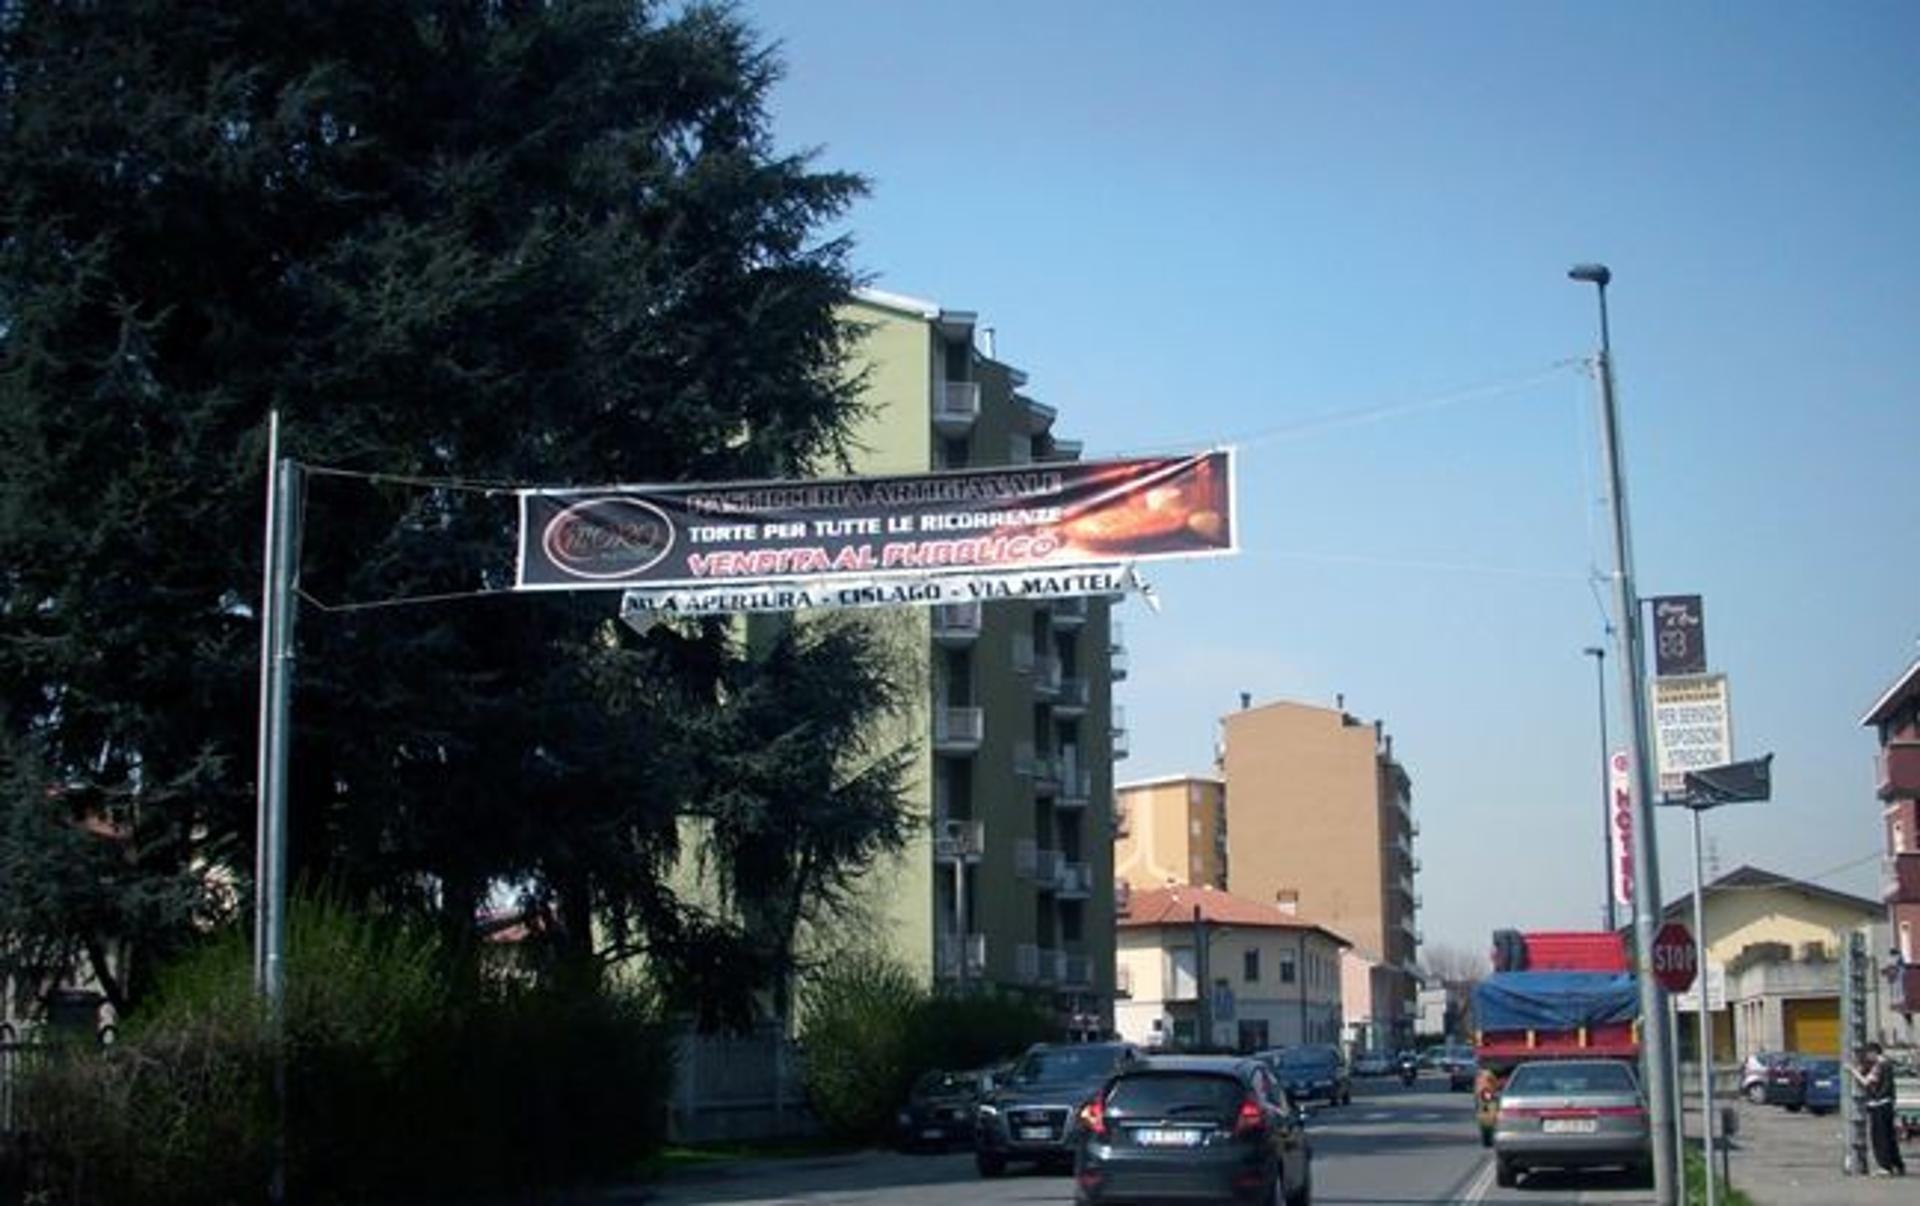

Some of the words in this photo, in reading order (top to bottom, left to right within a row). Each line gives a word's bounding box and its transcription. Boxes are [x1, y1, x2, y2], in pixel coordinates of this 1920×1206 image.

[688, 523, 758, 543] TORTE
[763, 521, 807, 539] PER
[814, 517, 882, 537] TUTTE
[888, 514, 914, 534] LE
[920, 507, 1062, 531] RICORRENZE
[687, 546, 832, 577] VENDITA
[832, 543, 878, 571] AL
[882, 534, 1058, 568] PUBBLICO
[687, 590, 813, 611] APERTURA
[838, 583, 941, 606] CISLAGO
[968, 579, 1013, 597] VIA
[1655, 945, 1695, 973] STOP
